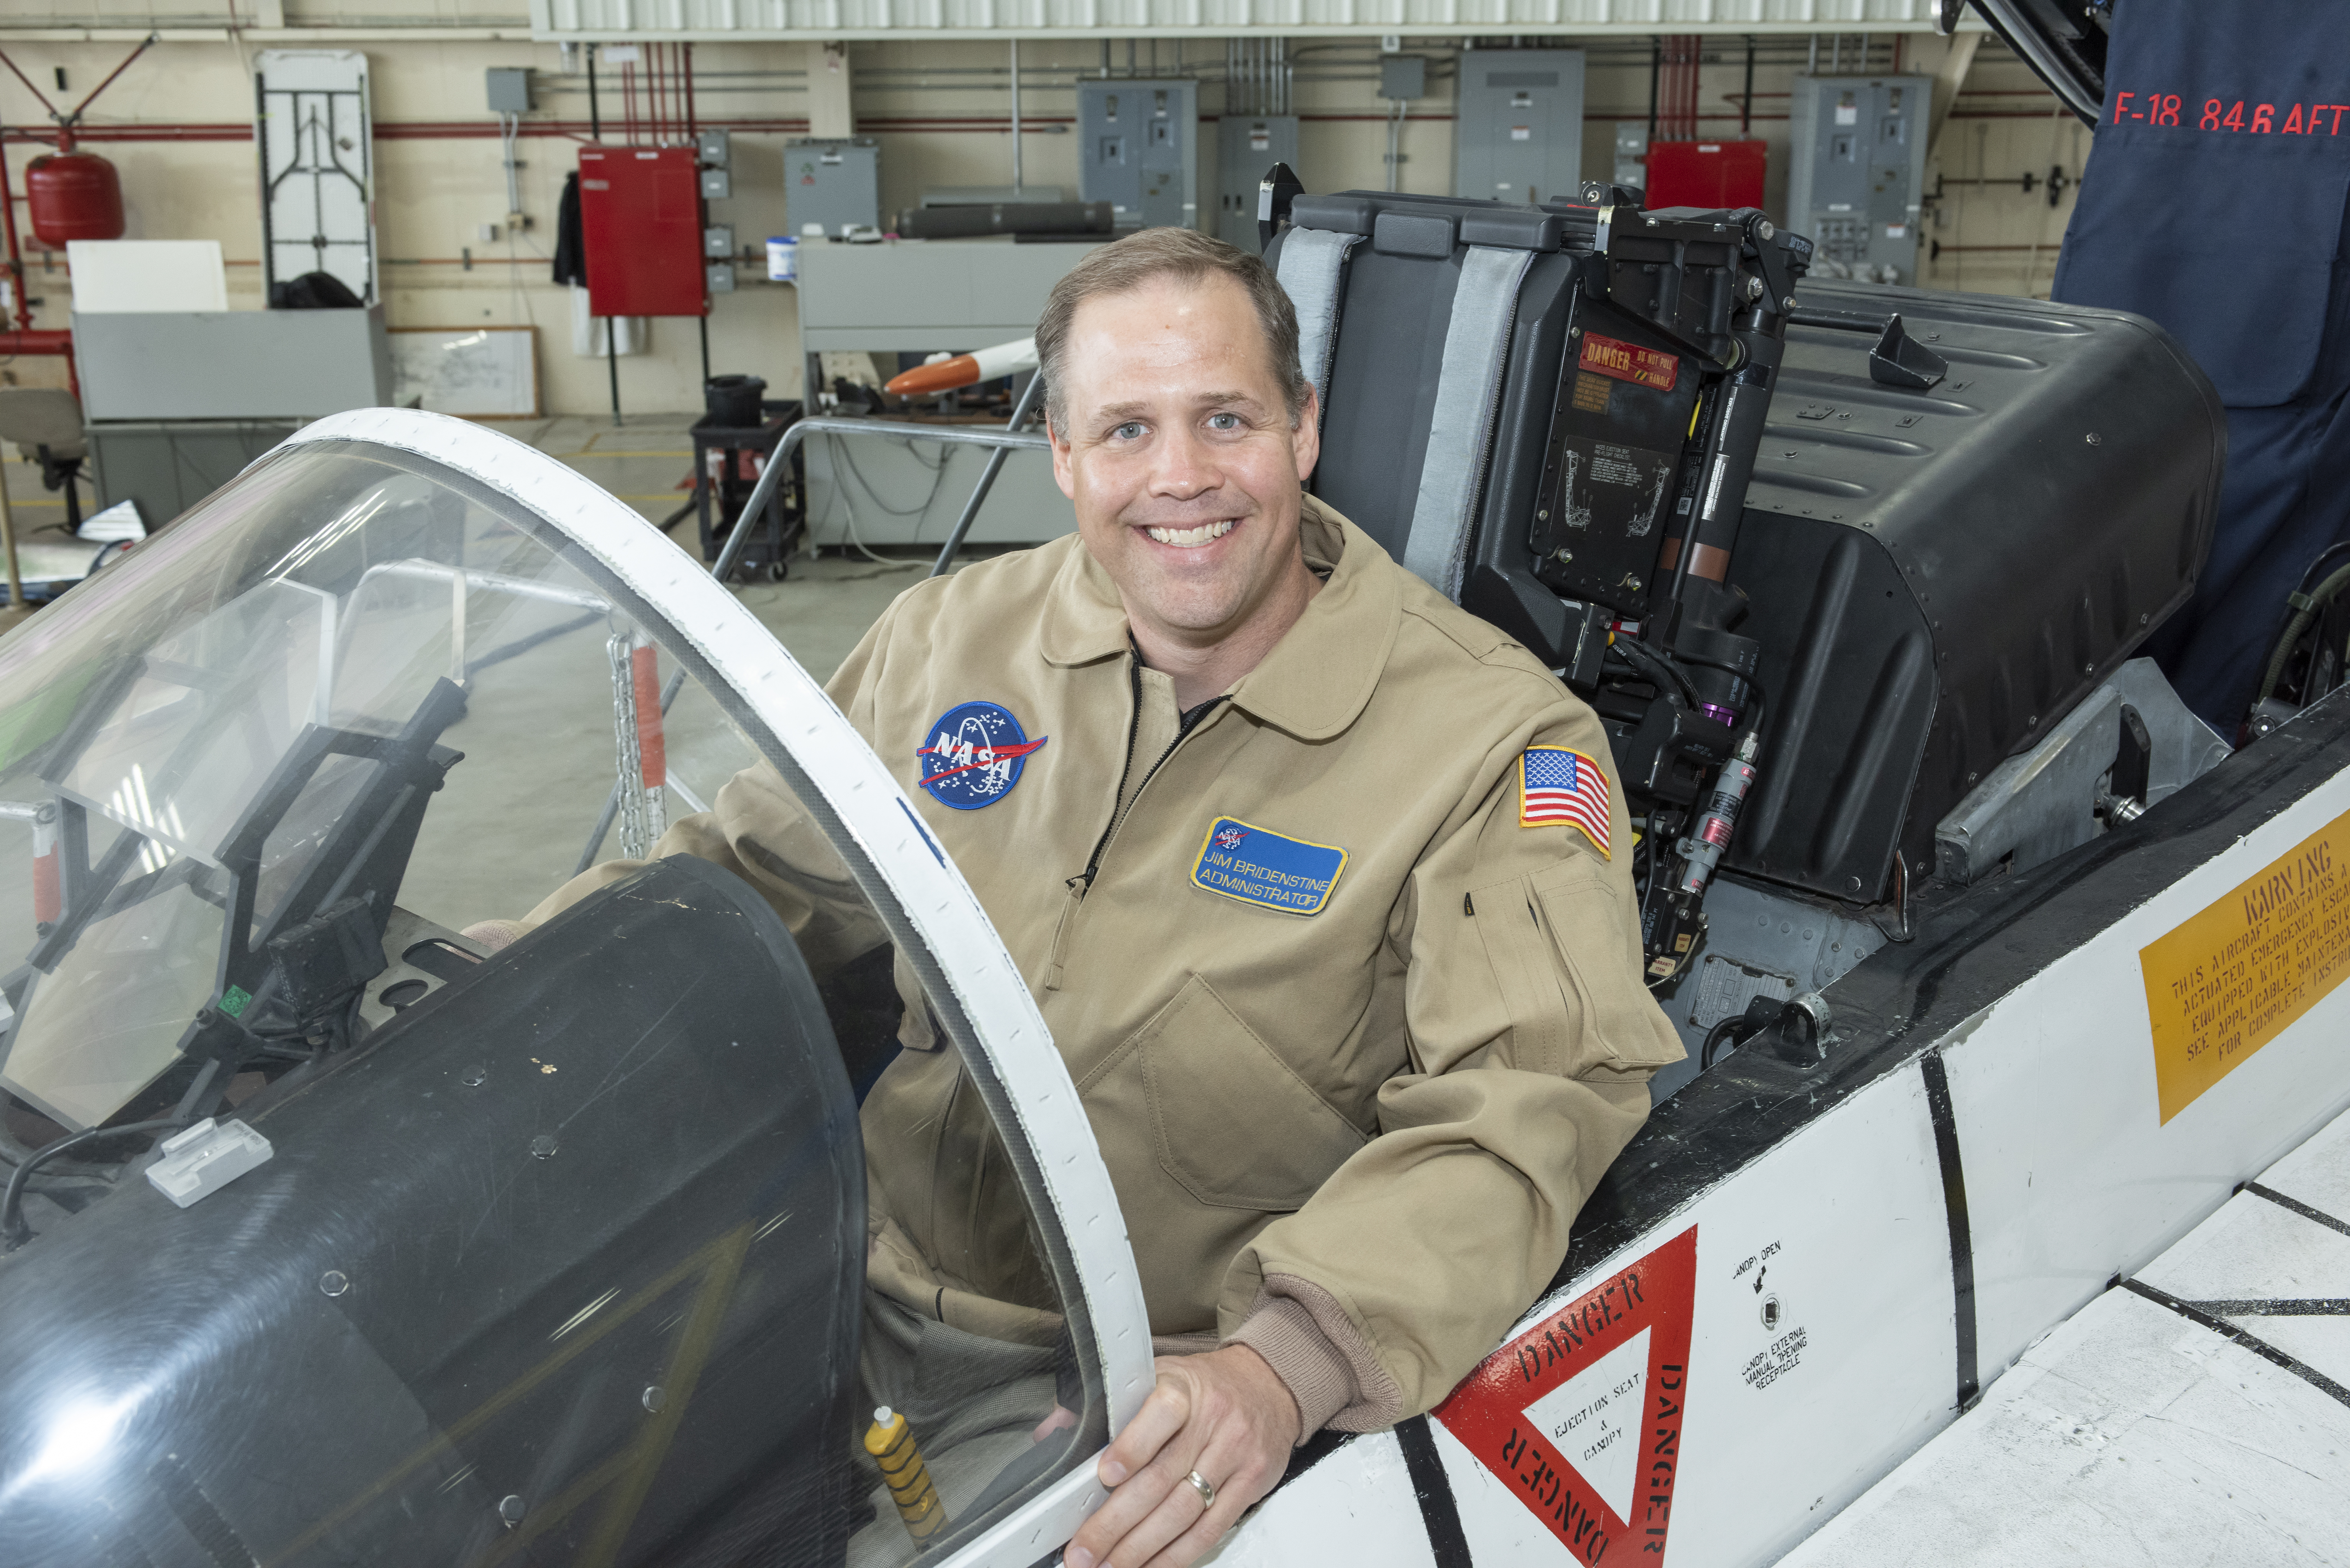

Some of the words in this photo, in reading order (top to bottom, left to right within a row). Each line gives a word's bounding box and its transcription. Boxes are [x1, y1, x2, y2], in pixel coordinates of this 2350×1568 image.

[2114, 92, 2182, 126] F-18
[2282, 103, 2350, 136] AFT
[1587, 343, 1630, 371] DANGER
[1637, 351, 1645, 362] DO
[1647, 354, 1659, 365] NOT
[1660, 357, 1672, 370] PULL
[1649, 372, 1670, 387] HANDLE
[1724, 397, 1733, 419] EXPLOSIVE
[1720, 419, 1728, 441] ORDNANCE
[933, 732, 1011, 782] NASA
[1218, 831, 1240, 845] NASA
[1199, 868, 1318, 907] ADMINISTRATOR
[1205, 851, 1232, 868] JIM
[1233, 859, 1330, 891] BRIDENSTINE
[2172, 965, 2203, 998] THIS
[2212, 918, 2270, 972] AIRCRAFT
[2279, 872, 2334, 923] CONTAINS
[2341, 863, 2347, 879] A
[2184, 960, 2245, 1016] ACTUATED
[2251, 908, 2314, 967] EMERGENCY
[2322, 881, 2350, 914] ESCA
[1736, 975, 1744, 998] INCORPORATED
[2193, 977, 2253, 1034] EQUIPPED
[2260, 950, 2289, 983] WITH
[2188, 1032, 2209, 1061] SEE
[2219, 971, 2291, 1039] APPLICABLE
[2219, 1031, 2241, 1061] FOR
[2249, 981, 2305, 1037] COMPLETE
[1732, 1256, 1758, 1280] ANOPY
[1761, 1240, 1781, 1260] OPEN
[1518, 1273, 1644, 1383] DANGER
[1771, 1326, 1806, 1355] EXTERNAL
[1746, 1360, 1775, 1386] MANUAL
[1755, 1353, 1801, 1390] RECEPTACLE
[1555, 1394, 1609, 1439] EJECTION
[1613, 1373, 1640, 1398] SEAT
[1583, 1427, 1622, 1461] CANOPY
[1643, 1365, 1683, 1553] DANGER
[1502, 1427, 1609, 1568] DANGER
